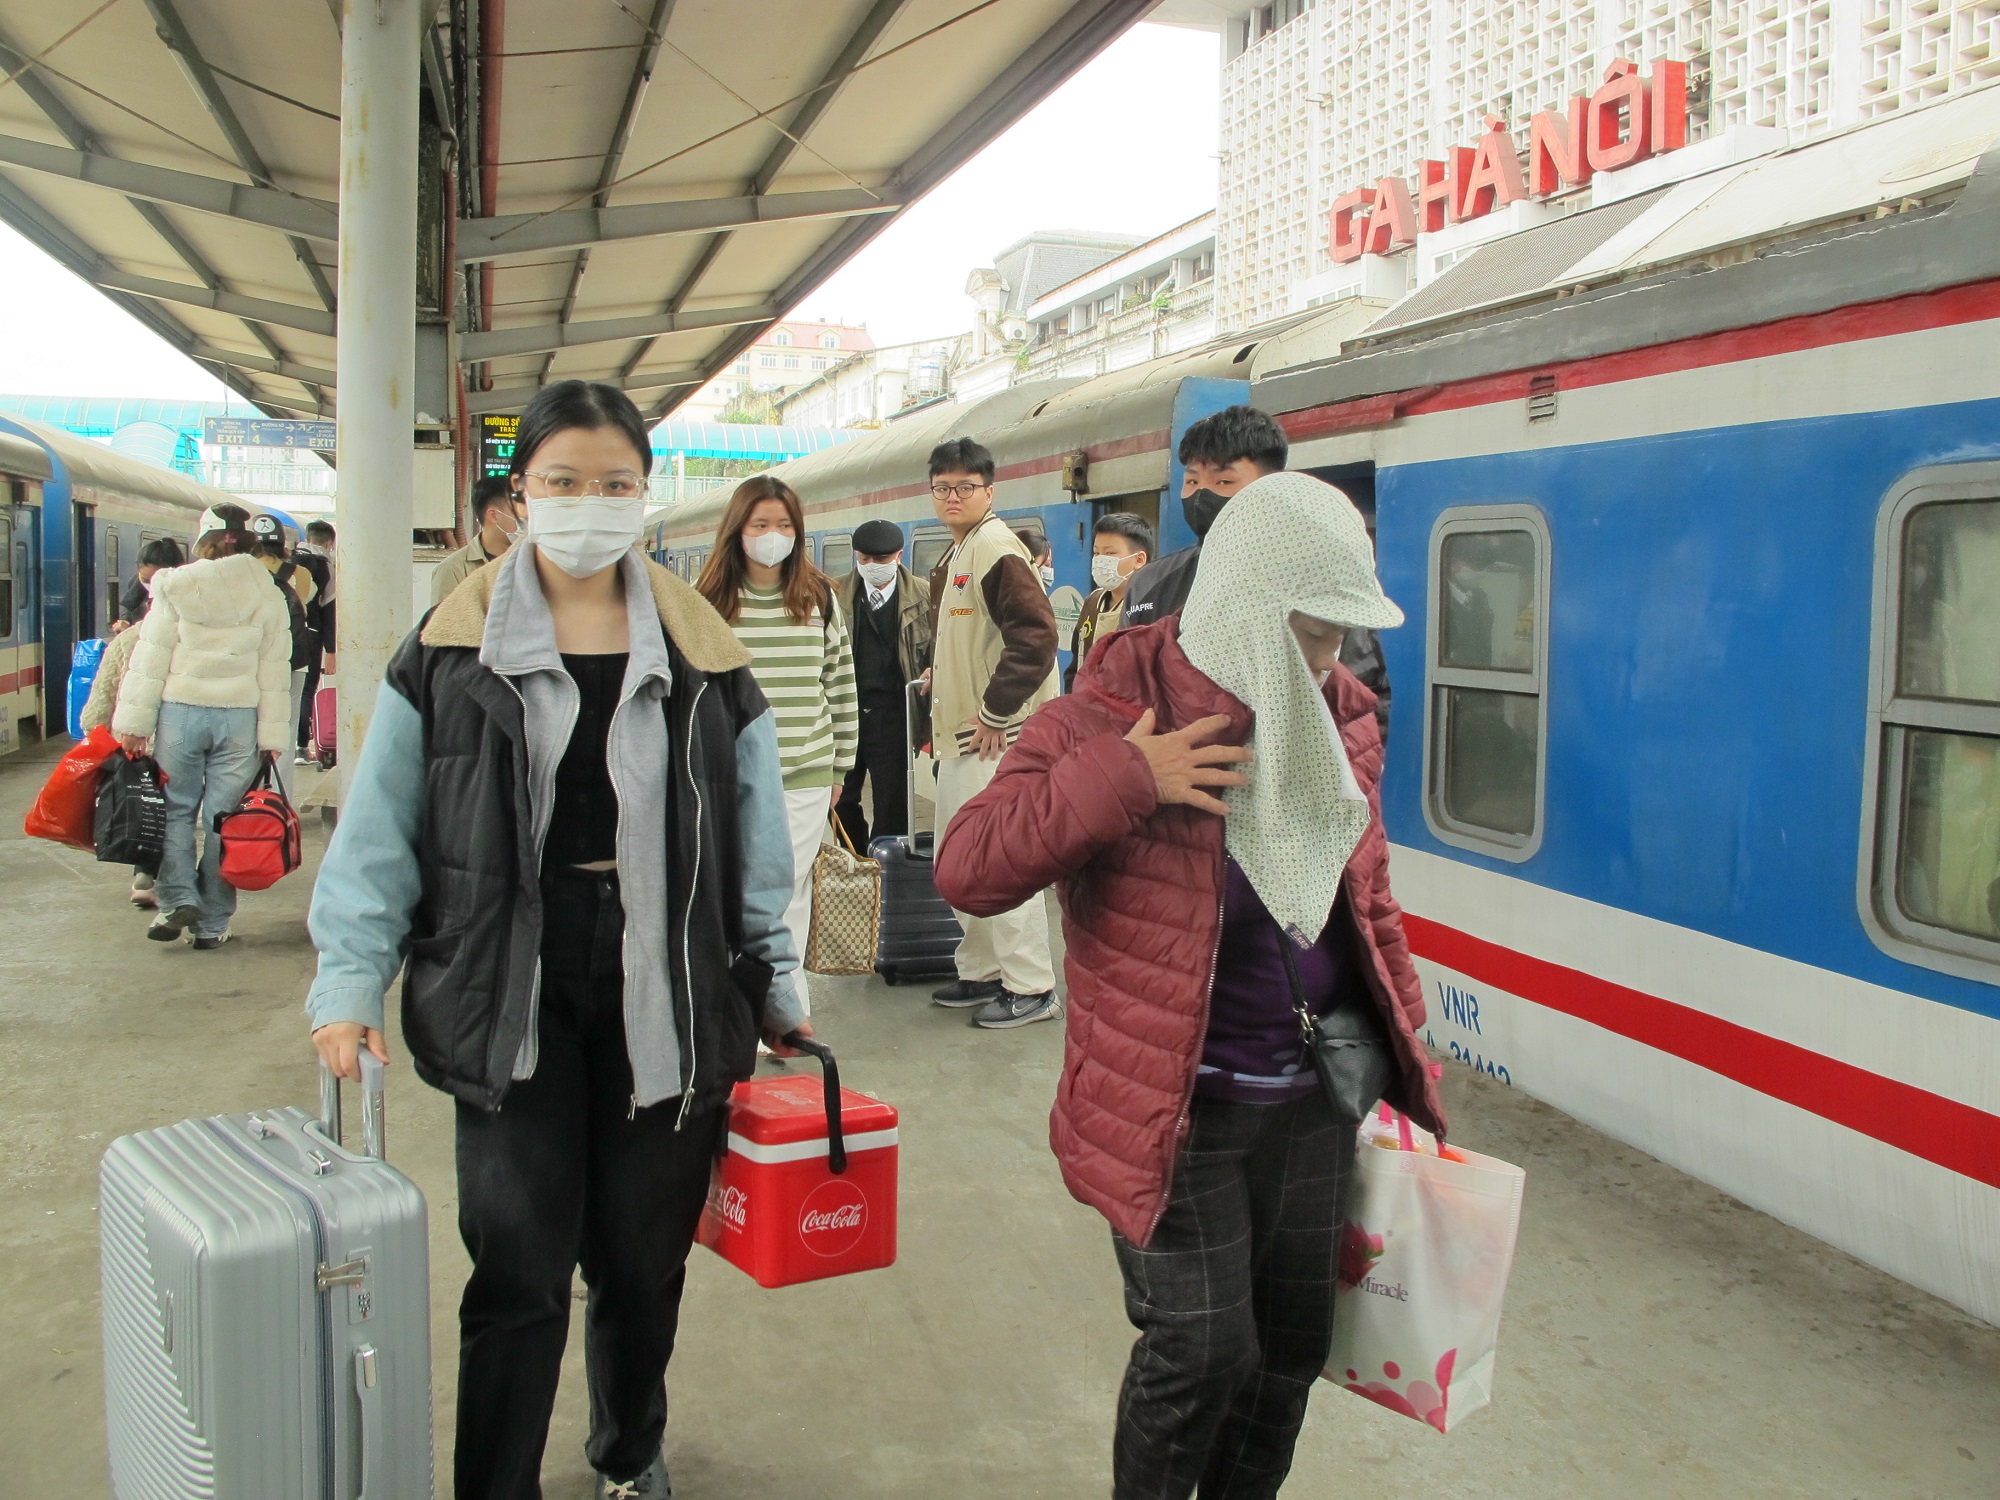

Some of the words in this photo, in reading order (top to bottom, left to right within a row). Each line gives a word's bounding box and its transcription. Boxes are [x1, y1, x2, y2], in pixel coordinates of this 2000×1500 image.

[1328, 177, 1417, 263] GA
[1419, 113, 1529, 232] HÀ
[216, 434, 245, 444] EXIT
[252, 434, 261, 445] 4
[285, 435, 294, 446] 3
[309, 438, 336, 448] EXIT
[1437, 980, 1482, 1036] VNR
